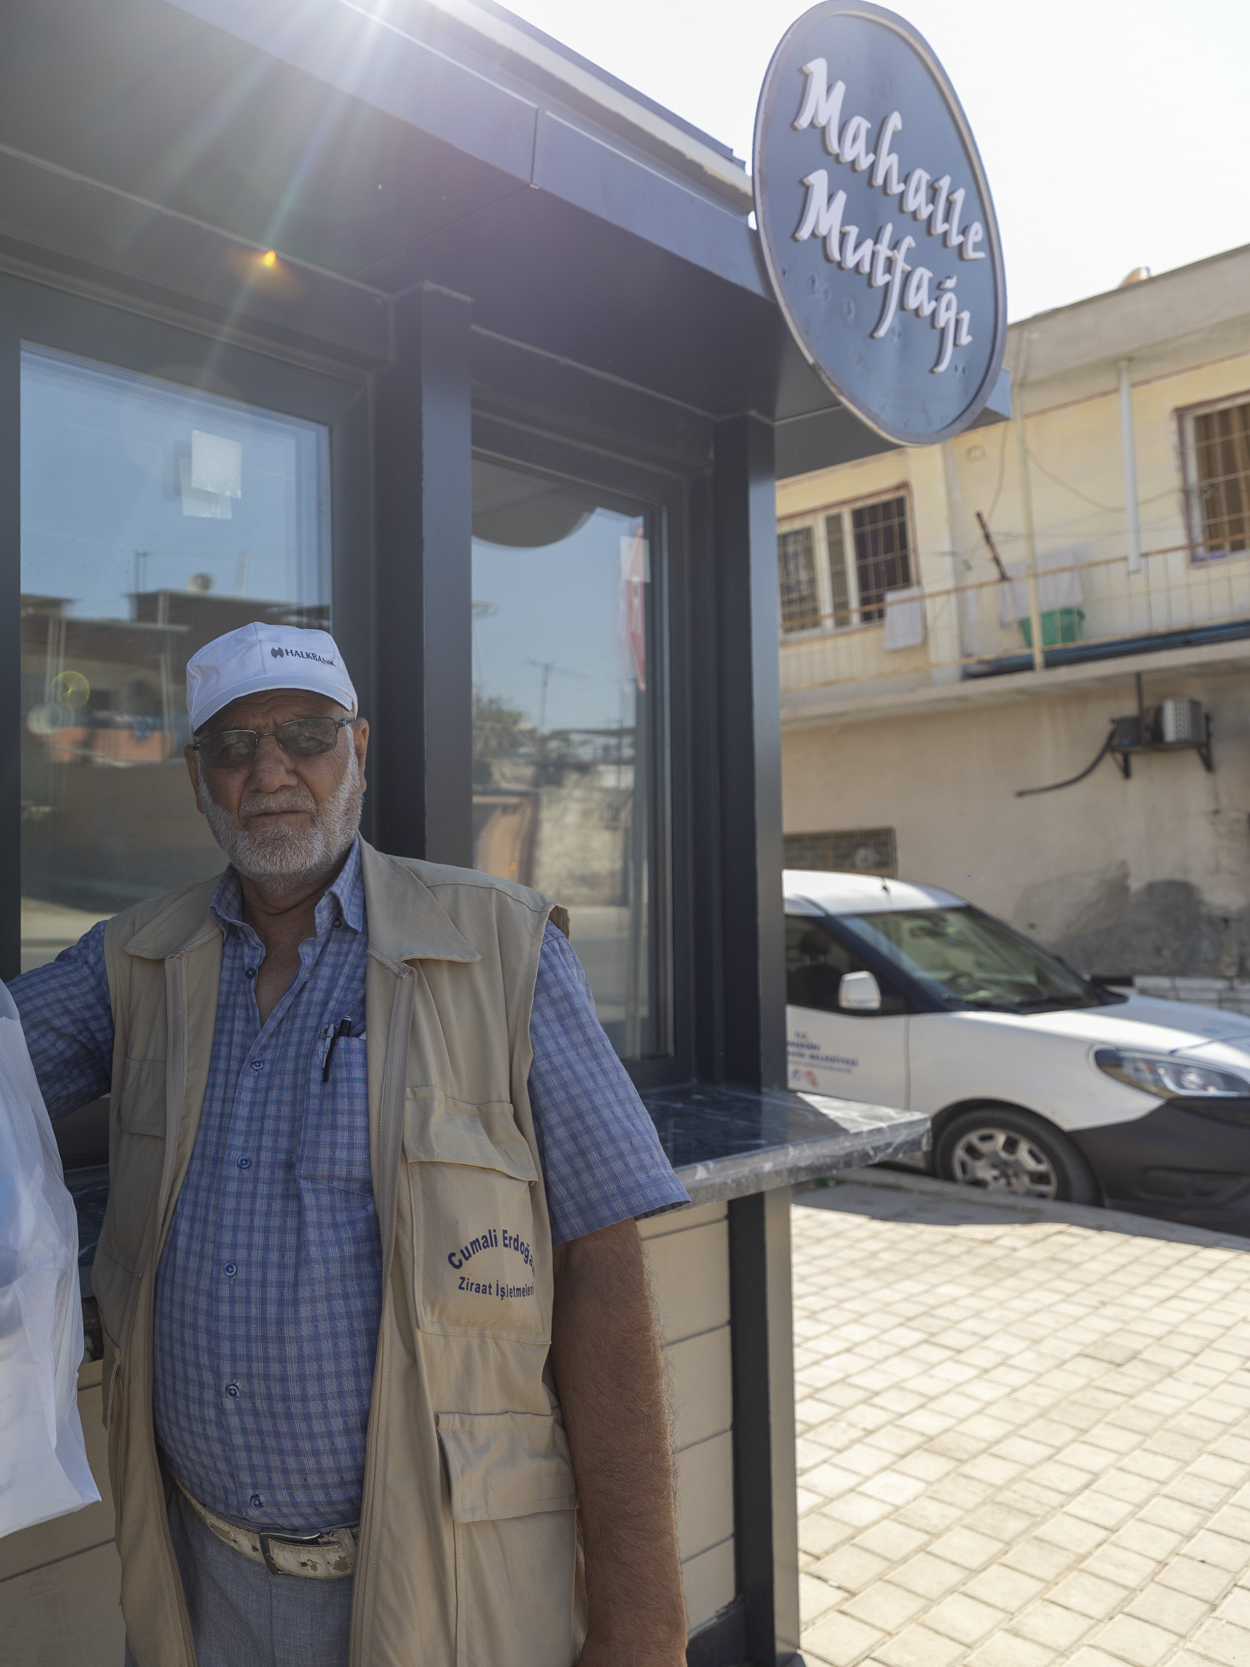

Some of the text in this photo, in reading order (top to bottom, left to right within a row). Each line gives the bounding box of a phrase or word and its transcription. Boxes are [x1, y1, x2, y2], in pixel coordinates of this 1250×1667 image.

[794, 57, 986, 261] Mahalle
[794, 168, 973, 374] Mutfağı
[284, 648, 336, 667] HALKBANK
[447, 1228, 499, 1270] Cumali
[458, 1276, 493, 1296] Ziraat
